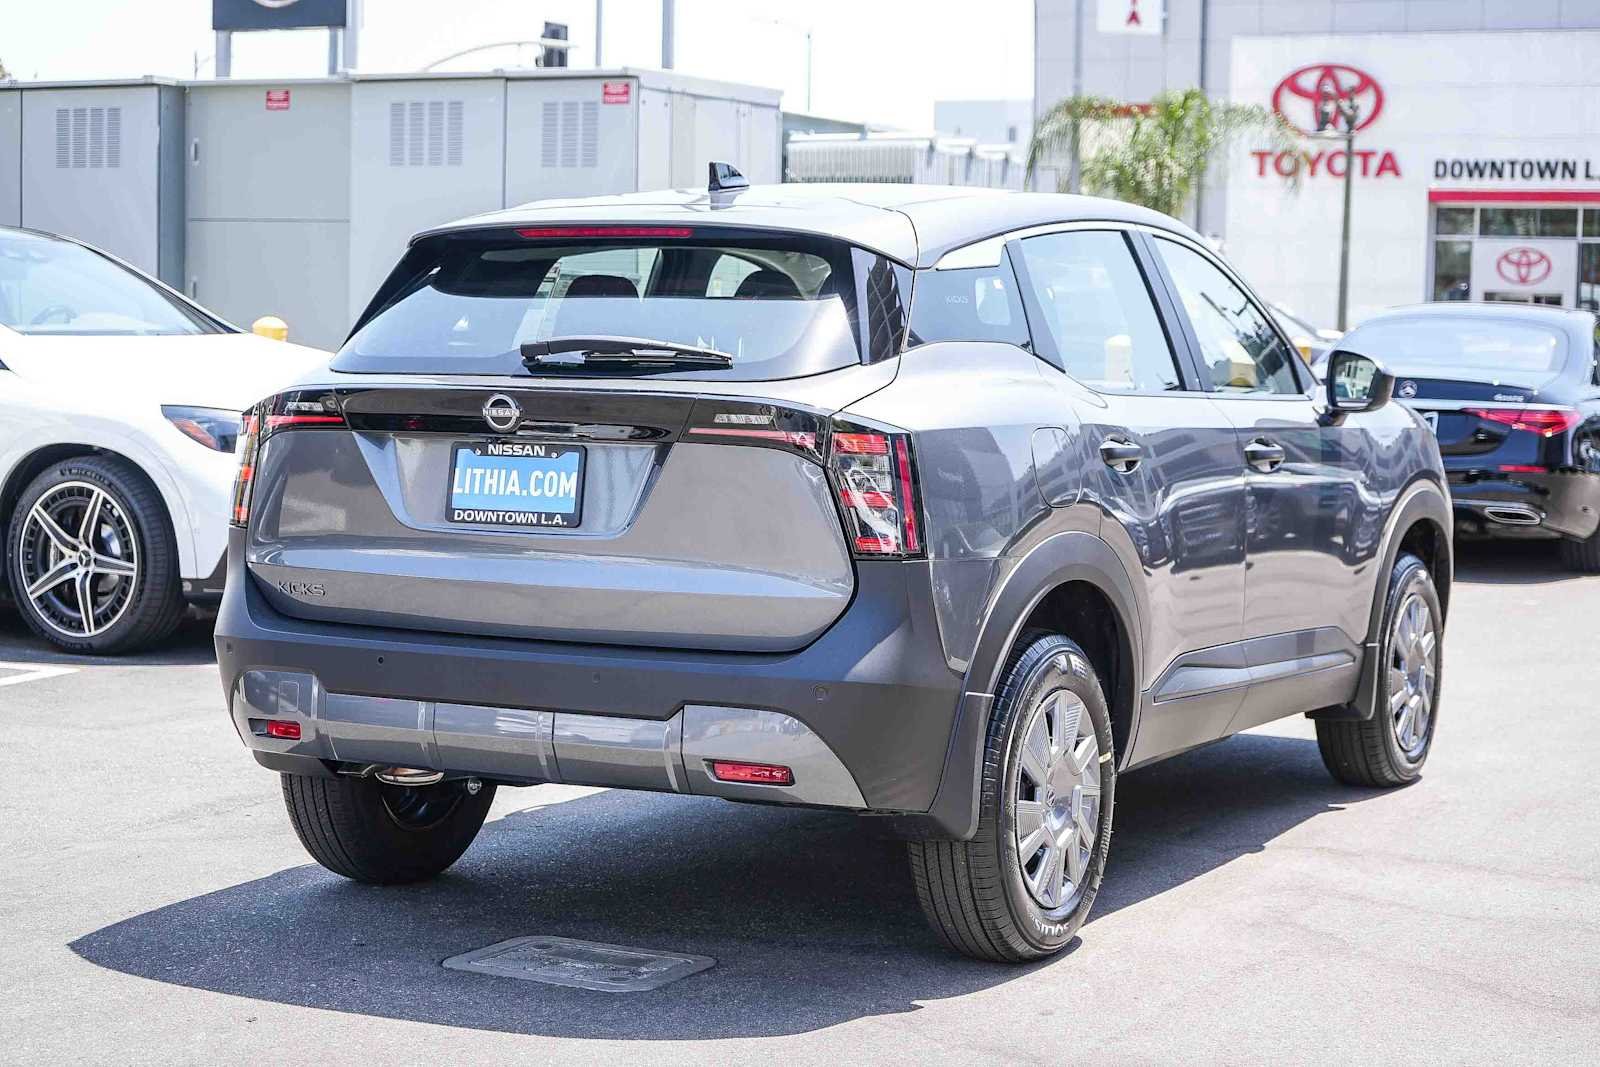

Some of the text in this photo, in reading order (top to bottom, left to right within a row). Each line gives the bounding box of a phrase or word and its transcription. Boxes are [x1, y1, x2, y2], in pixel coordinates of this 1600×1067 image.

[1250, 150, 1402, 177] TOYOTA
[1434, 160, 1577, 179] DOWNTOWN
[482, 407, 520, 417] NISSAN
[487, 444, 546, 457] NISSAN
[452, 467, 577, 498] LITHIA.COM
[453, 509, 568, 525] DOWNTOWN L.A.
[278, 580, 327, 597] KICKS
